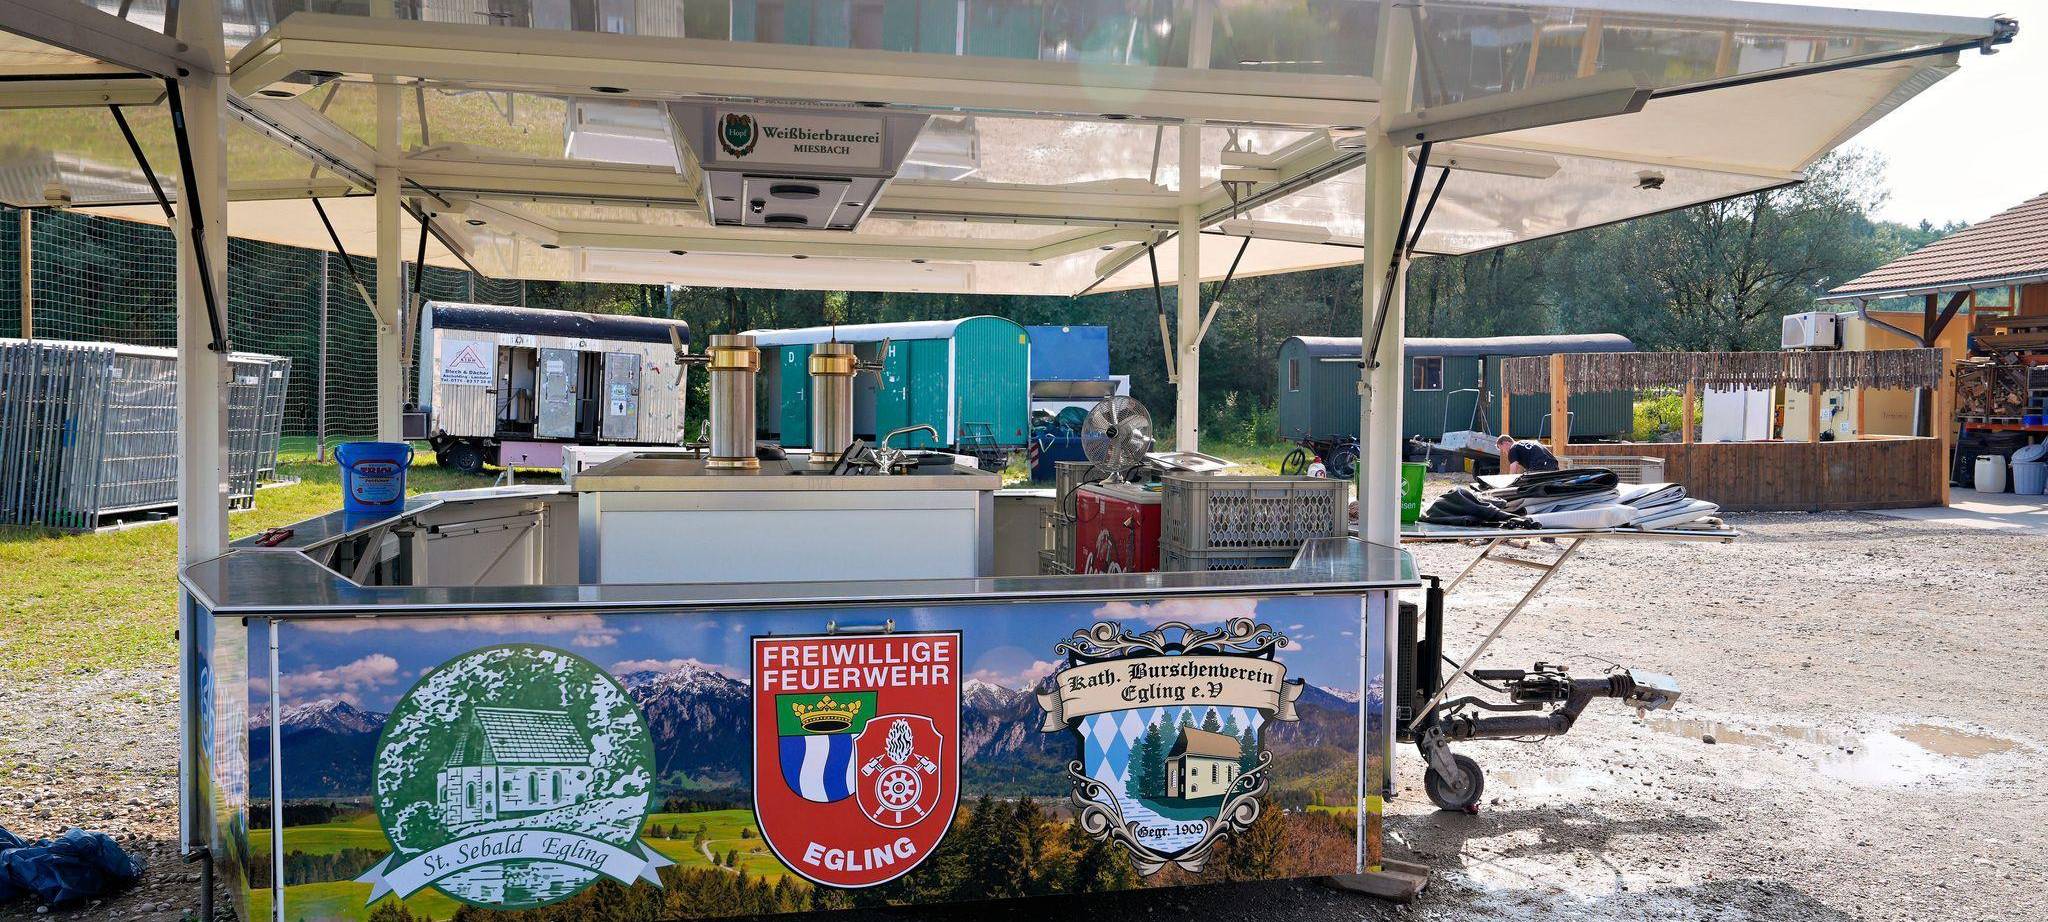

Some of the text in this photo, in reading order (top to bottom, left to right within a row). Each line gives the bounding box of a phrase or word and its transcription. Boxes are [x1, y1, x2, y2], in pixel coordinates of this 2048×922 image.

[728, 128, 747, 138] Hopf
[762, 126, 880, 144] Weißbierbrauerei
[793, 143, 850, 155] MIESBACH
[788, 351, 795, 363] D
[888, 345, 896, 358] H
[763, 641, 950, 668] FREIWILLIGE
[763, 665, 949, 691] FEUERWEHR
[1067, 660, 1274, 693] Kath. Burschenverein
[1121, 682, 1186, 704] Egling
[1137, 823, 1204, 839] Gegr. 1909
[423, 833, 609, 877] St. Sebald Egling
[802, 837, 917, 872] EGLING
